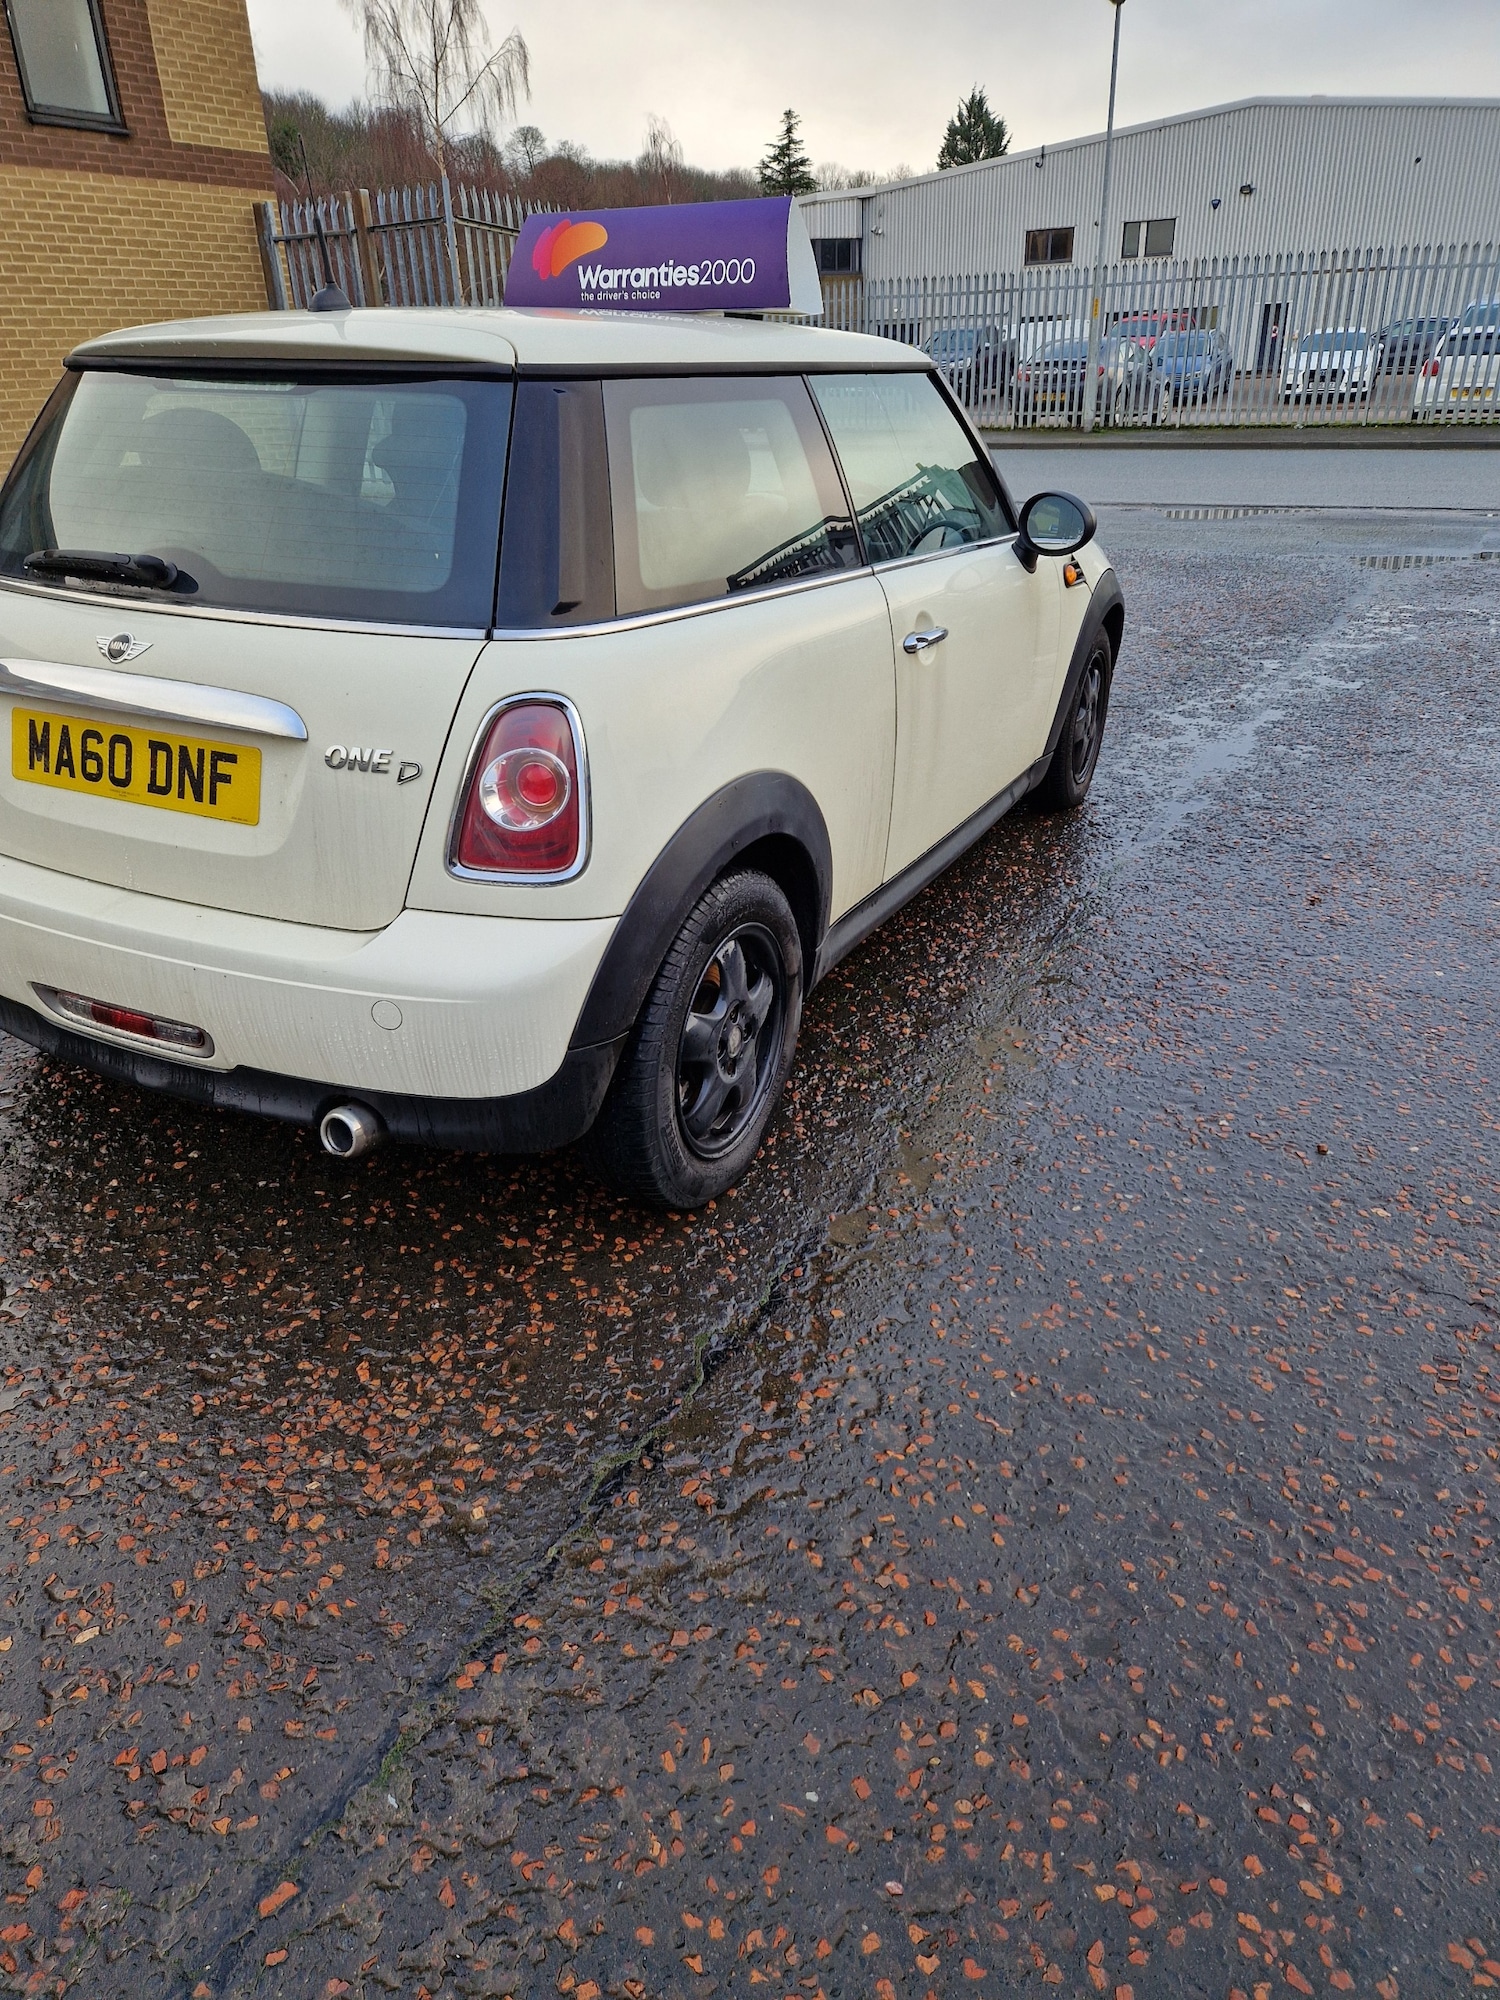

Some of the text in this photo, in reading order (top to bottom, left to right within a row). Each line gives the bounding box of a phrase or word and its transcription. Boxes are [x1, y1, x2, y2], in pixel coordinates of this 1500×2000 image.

[578, 258, 755, 289] Warranties2000
[581, 289, 661, 301] the driver's choice
[109, 641, 129, 651] MINI
[29, 719, 238, 806] MA60 DNF
[325, 744, 423, 785] ONE D
